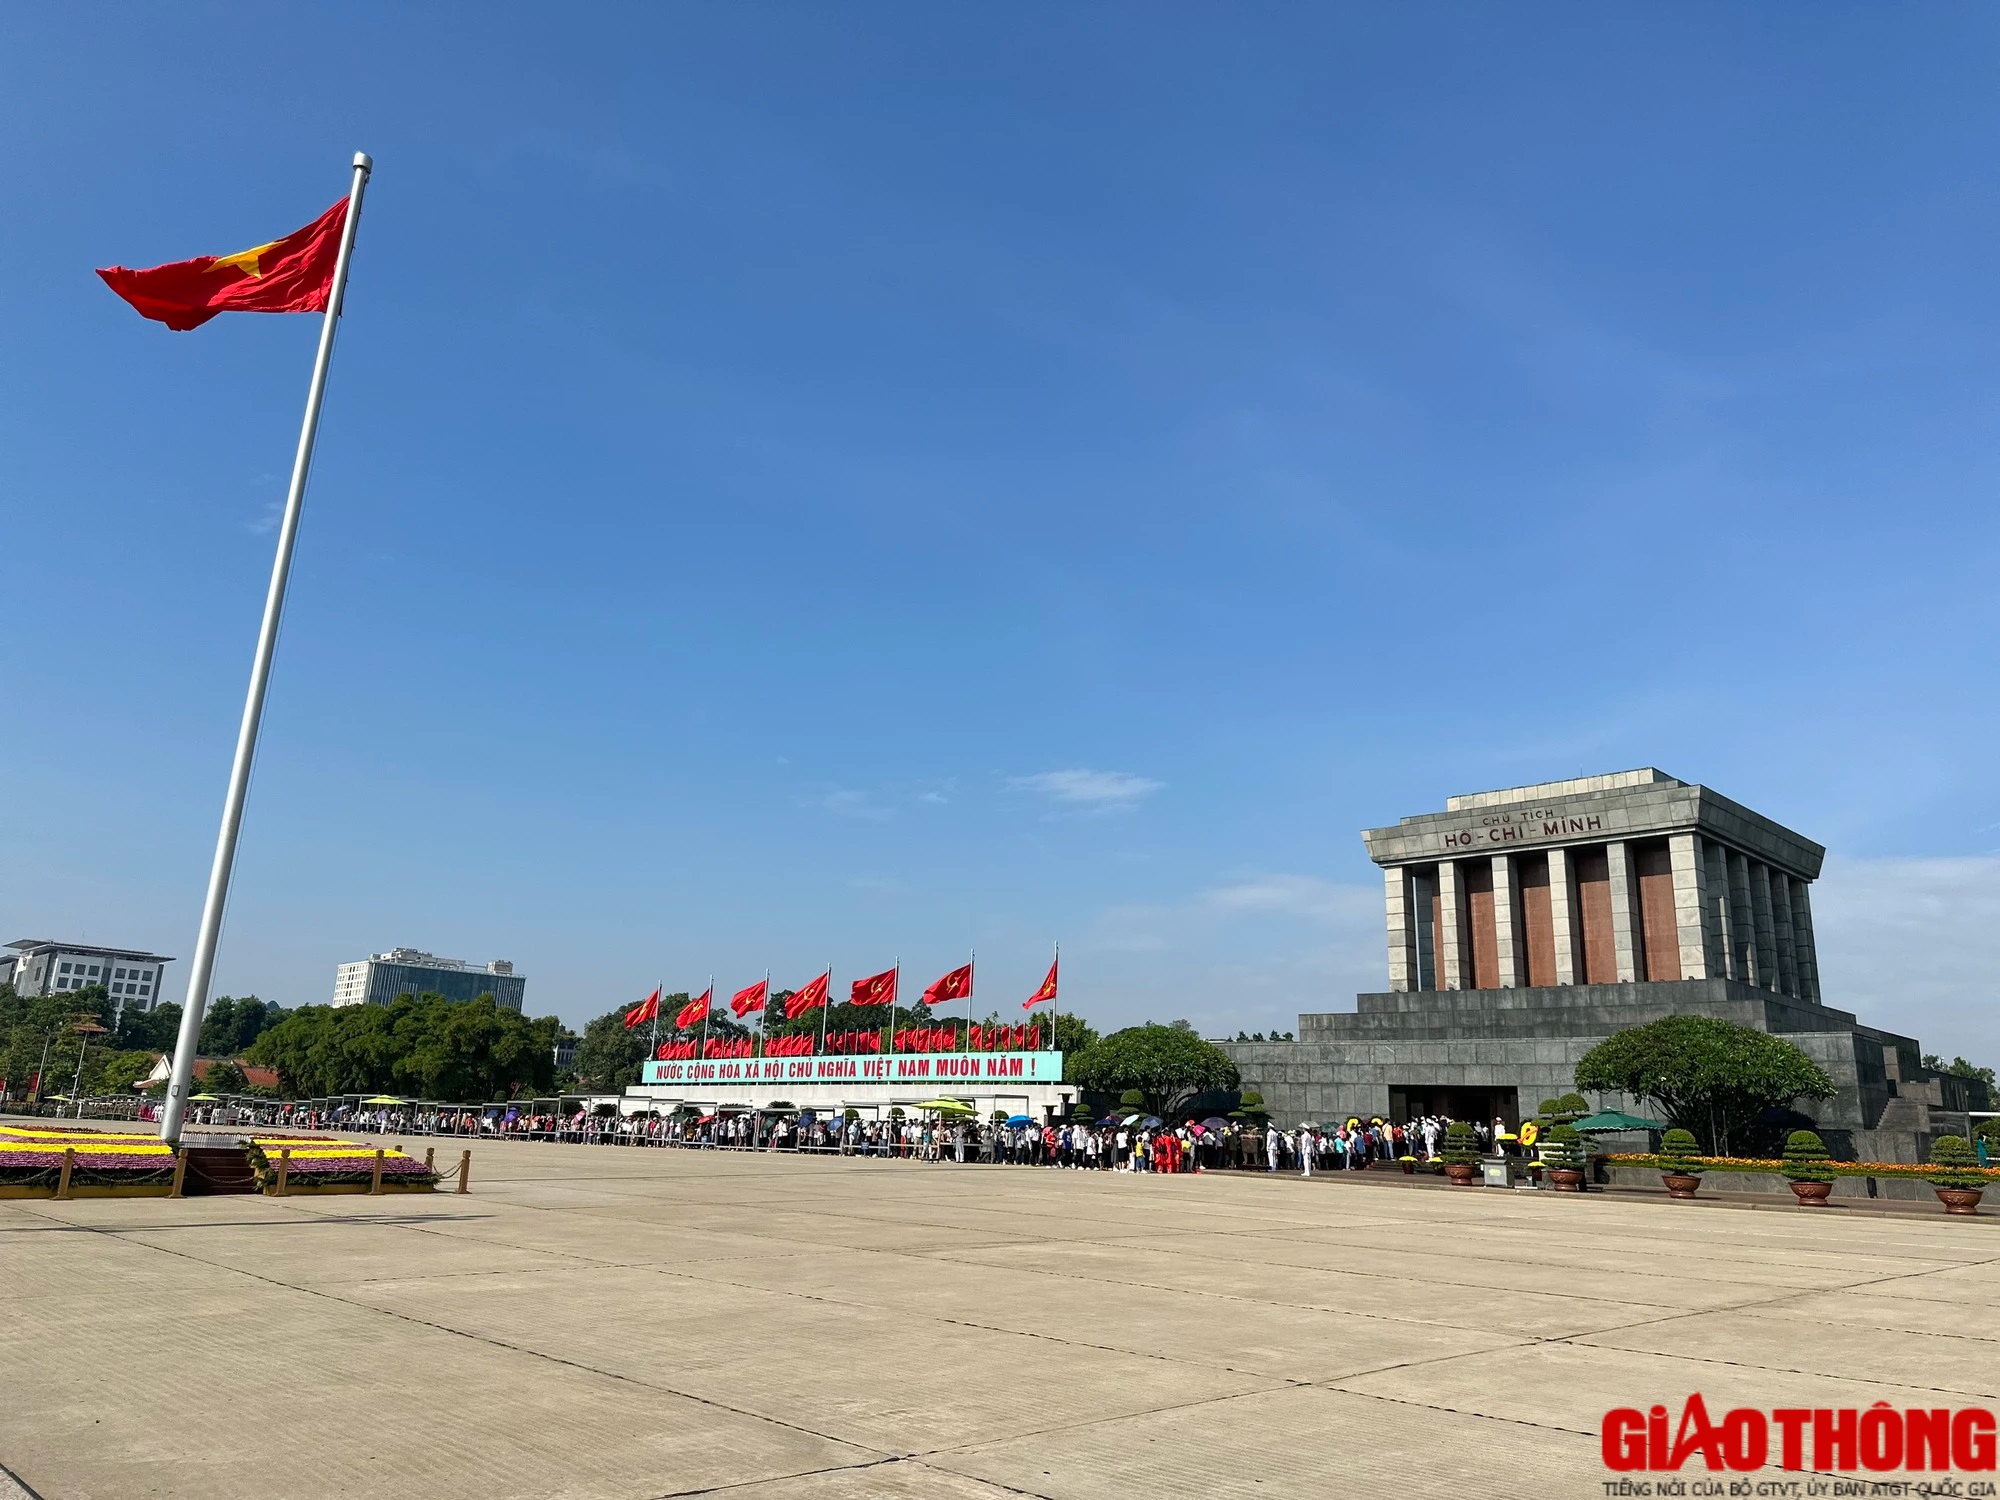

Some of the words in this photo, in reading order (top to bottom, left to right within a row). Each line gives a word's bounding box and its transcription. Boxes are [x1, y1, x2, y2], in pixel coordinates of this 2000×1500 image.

[1482, 811, 1511, 826] CHỦ
[656, 1063, 683, 1080] NƯỚC
[686, 1062, 715, 1081] CỘNG
[718, 1061, 740, 1079] HÒA
[744, 1060, 759, 1079] XÃ
[763, 1060, 784, 1081] HỘI
[788, 1058, 813, 1079] CHỦ
[817, 1058, 857, 1078] NGHĨA
[863, 1057, 893, 1080] VIỆT
[898, 1059, 930, 1077] NAM
[935, 1055, 980, 1077] MUÔN
[987, 1054, 1023, 1077] NĂM
